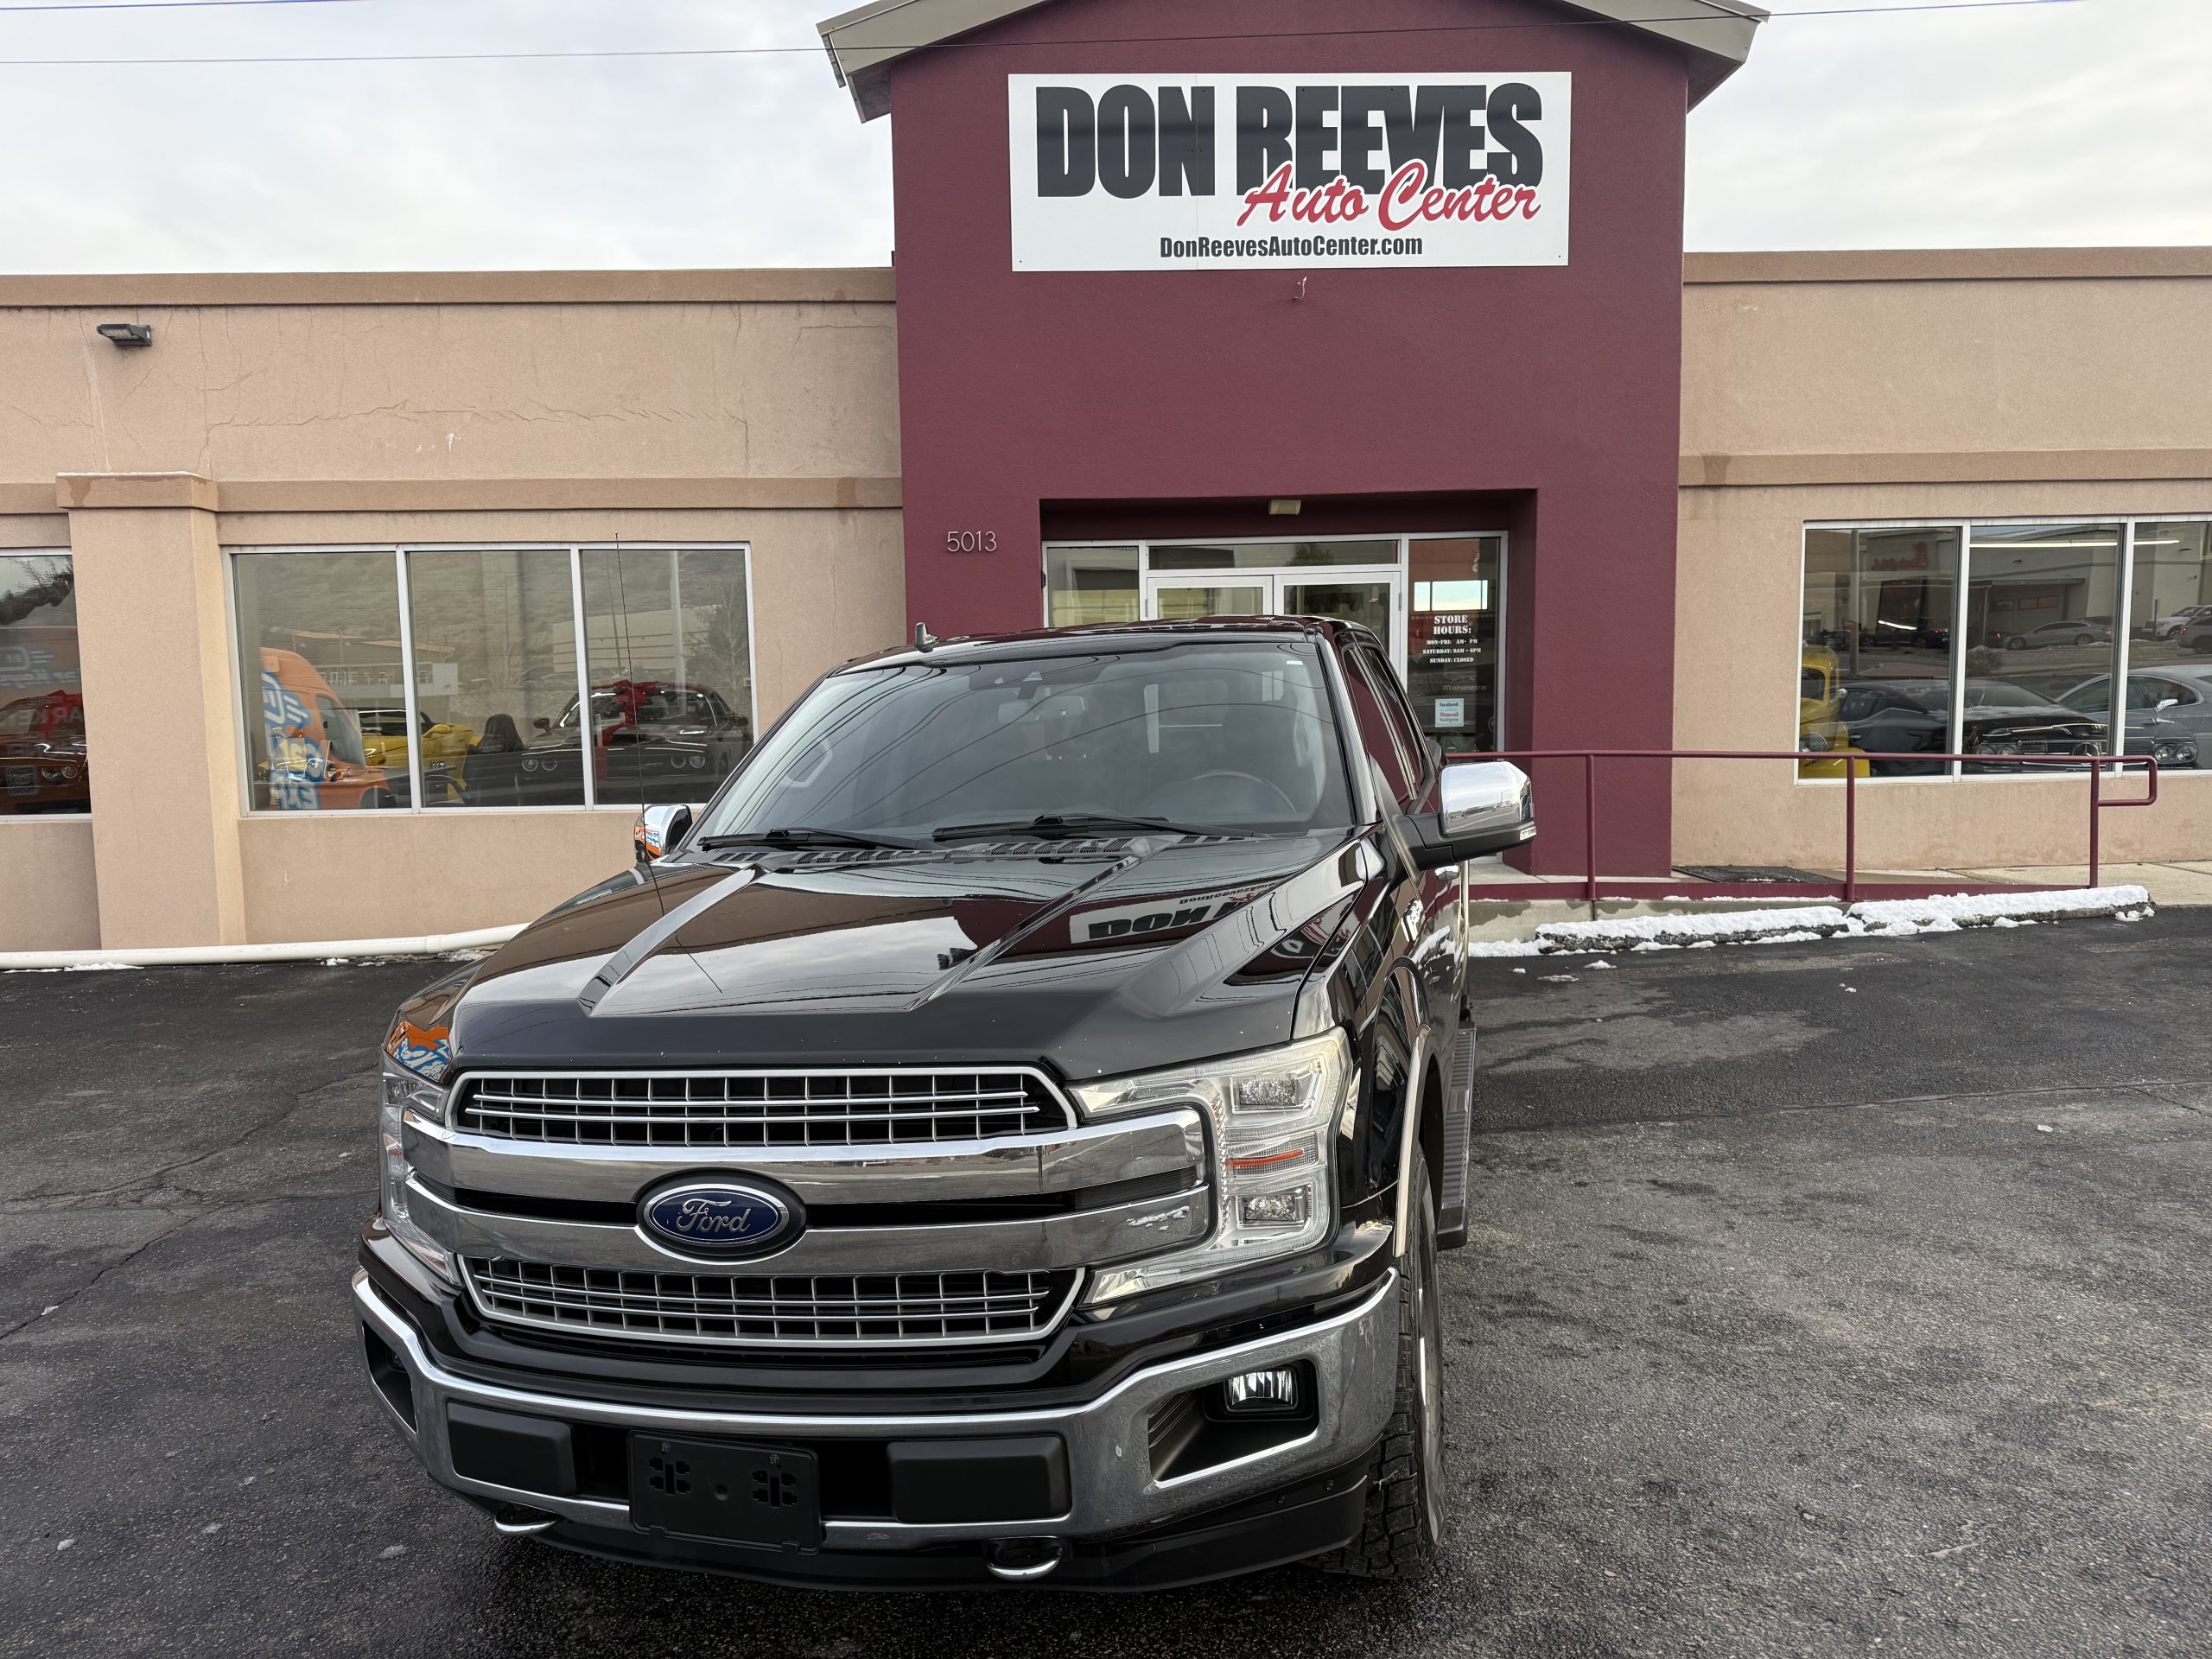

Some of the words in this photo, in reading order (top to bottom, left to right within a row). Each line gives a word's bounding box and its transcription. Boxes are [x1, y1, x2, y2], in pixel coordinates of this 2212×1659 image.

[1037, 85, 1215, 199] DON
[1236, 83, 1543, 196] REEVES
[1236, 162, 1369, 227] Auto
[1378, 158, 1542, 231] Center
[1160, 235, 1423, 258] DonReevesAutoCenter.com
[947, 531, 997, 552] 5013
[1433, 614, 1468, 625] STORE
[1433, 626, 1471, 635] HOURS:
[676, 1198, 751, 1233] Ford
